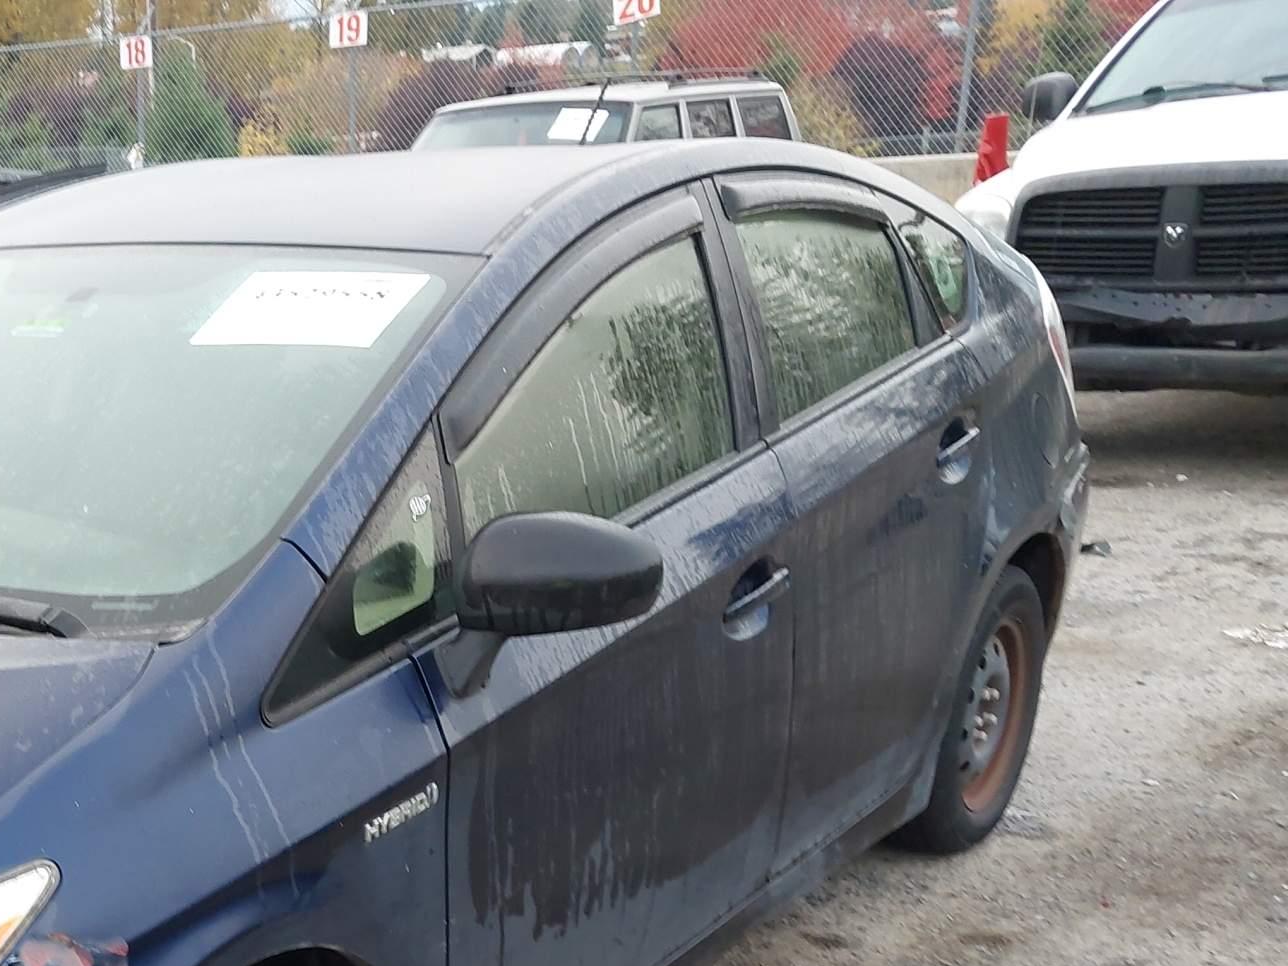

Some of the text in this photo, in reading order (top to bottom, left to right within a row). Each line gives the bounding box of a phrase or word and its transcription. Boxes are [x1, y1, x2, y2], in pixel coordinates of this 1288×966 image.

[336, 14, 360, 42] 19
[126, 38, 146, 65] 18
[364, 789, 432, 843] HYBRID
